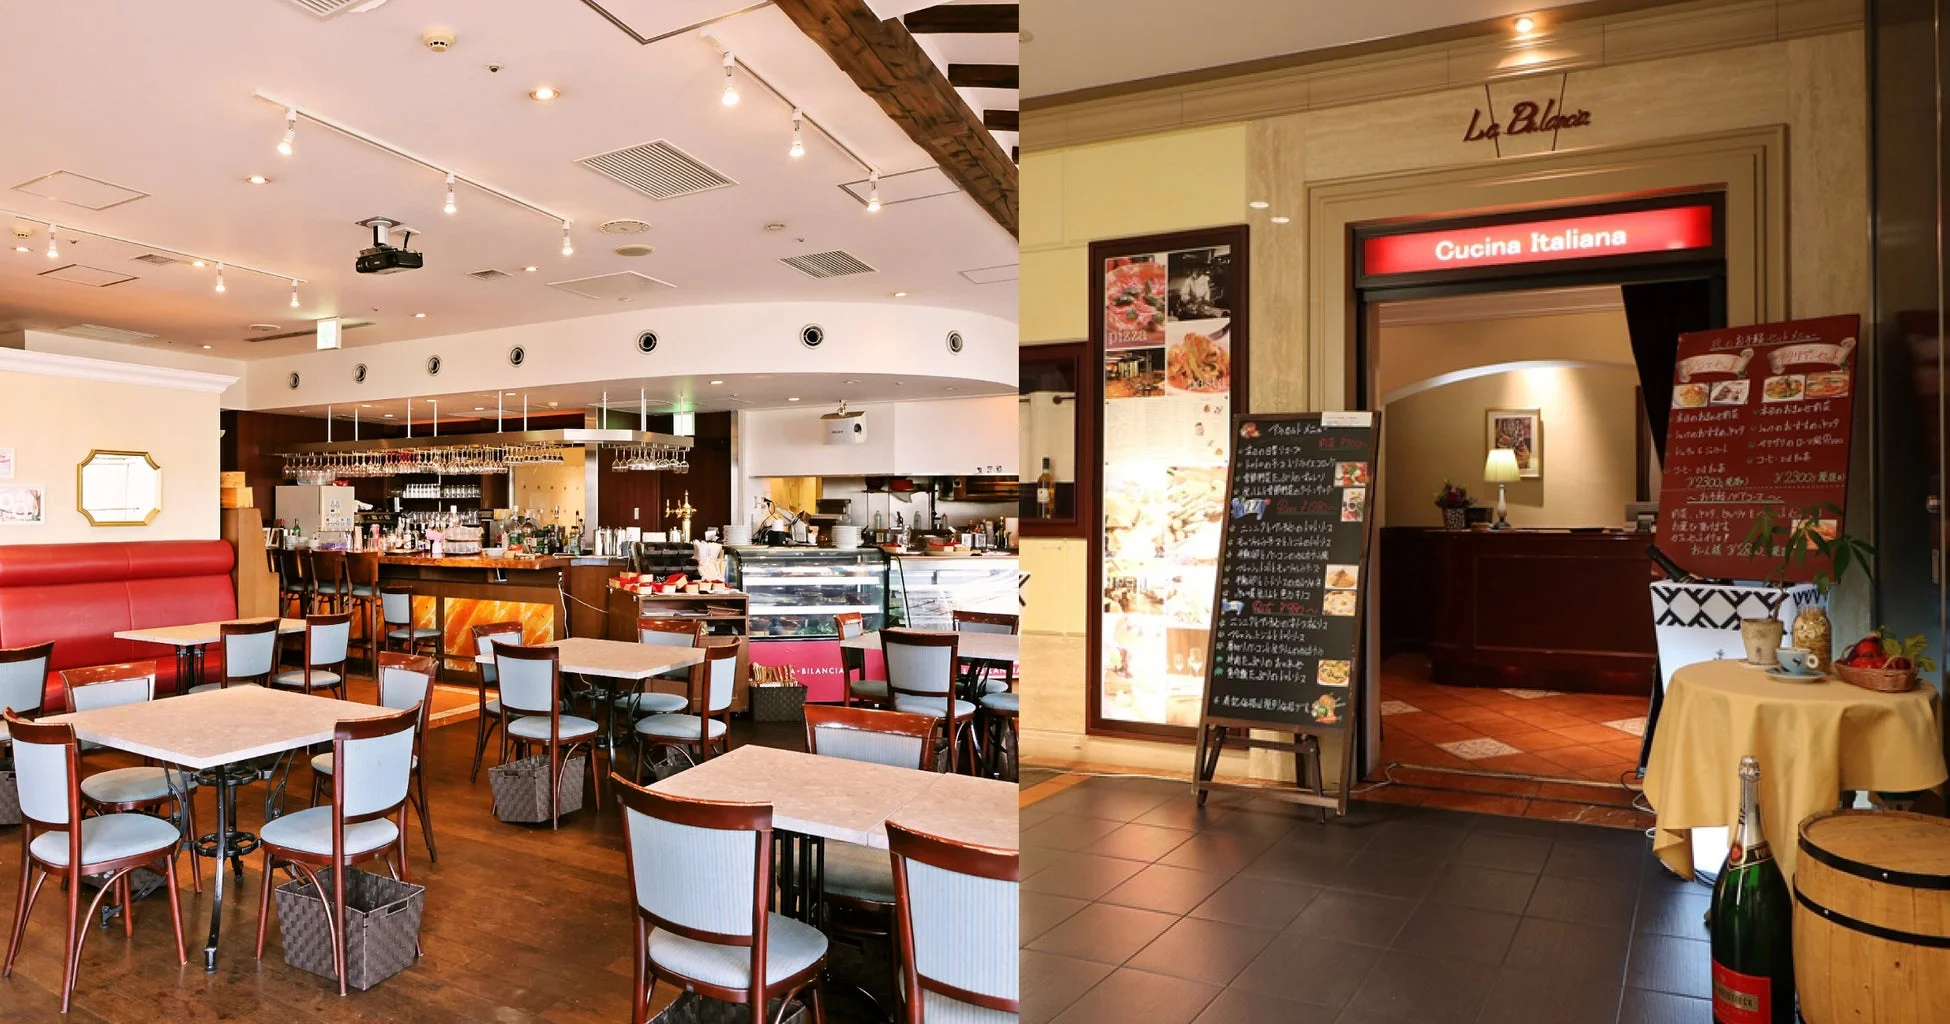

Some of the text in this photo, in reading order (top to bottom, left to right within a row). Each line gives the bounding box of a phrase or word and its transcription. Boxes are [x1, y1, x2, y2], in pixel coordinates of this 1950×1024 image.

[1463, 108, 1500, 143] La
[1434, 226, 1628, 262] Cucina Italiana
[1108, 329, 1148, 346] pizza
